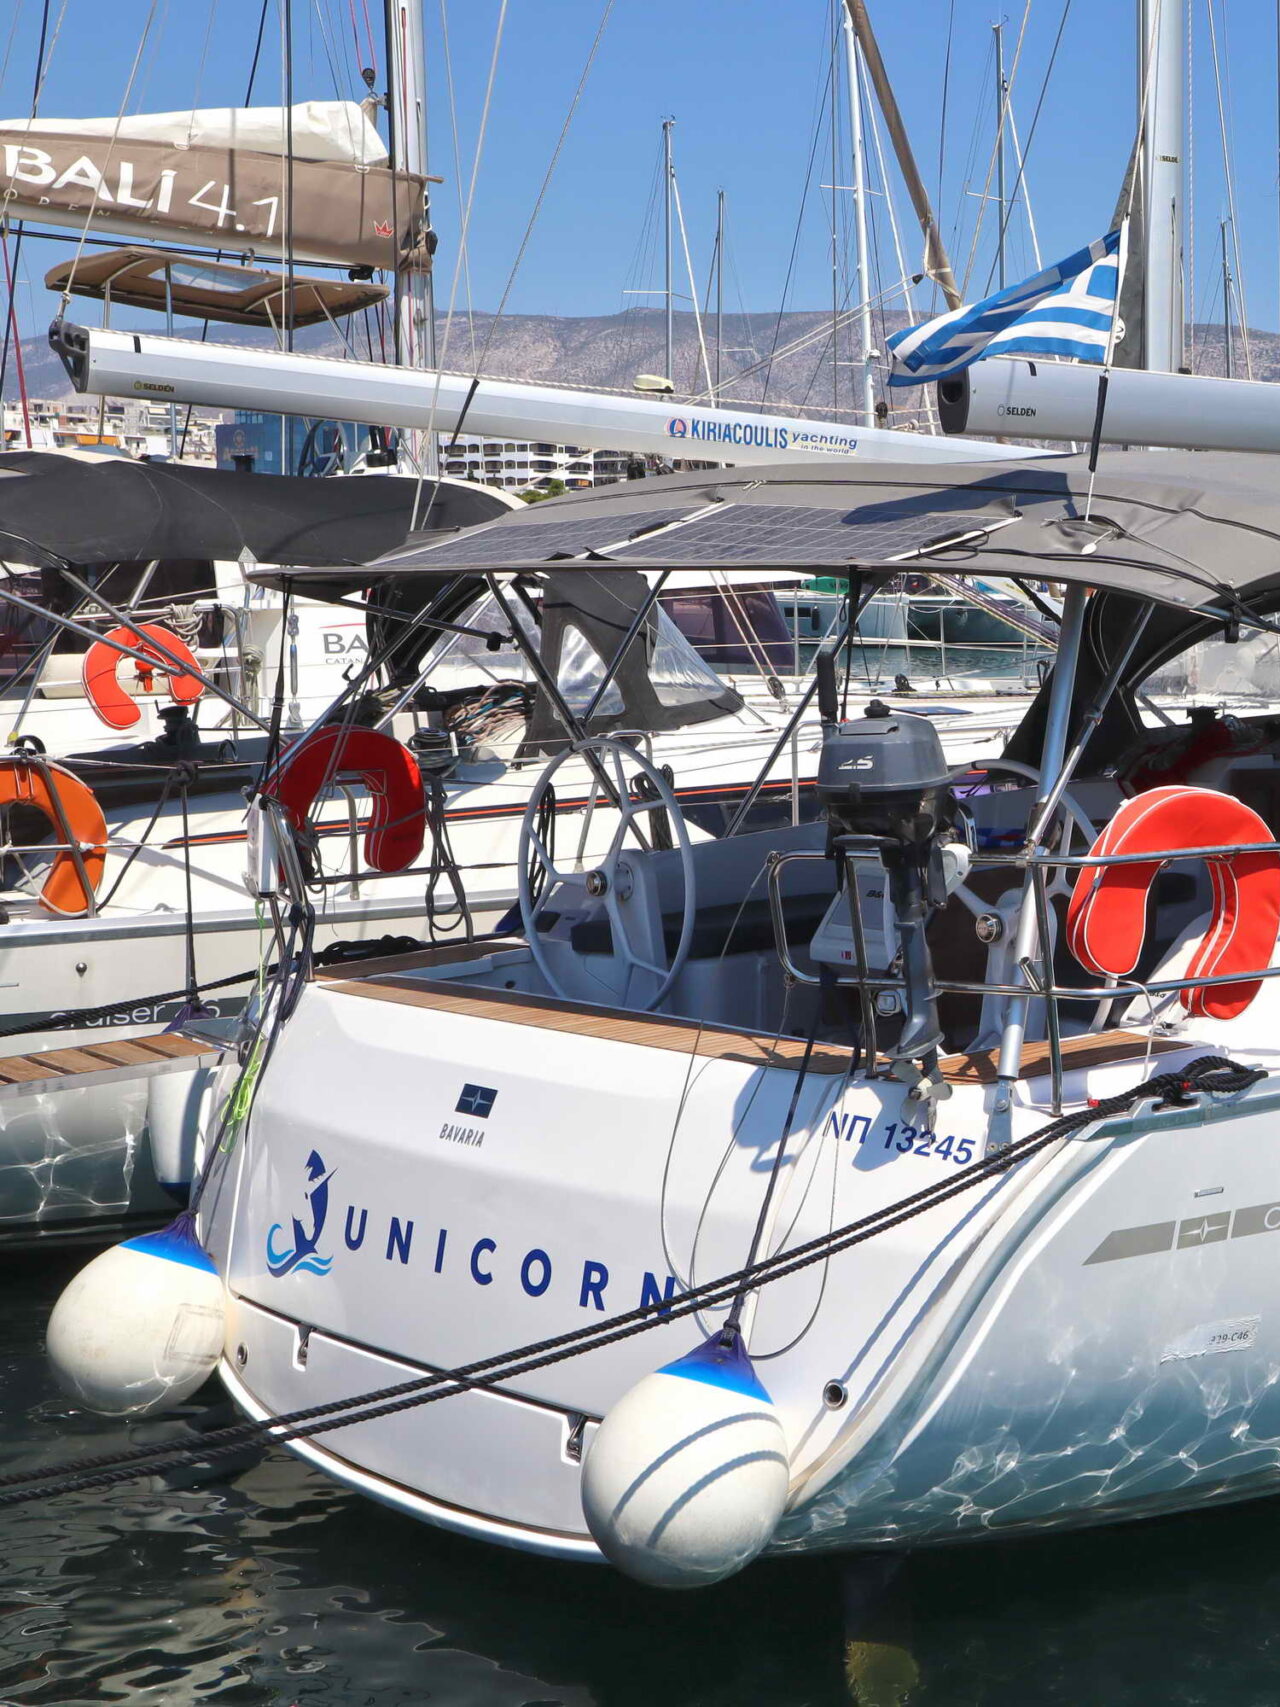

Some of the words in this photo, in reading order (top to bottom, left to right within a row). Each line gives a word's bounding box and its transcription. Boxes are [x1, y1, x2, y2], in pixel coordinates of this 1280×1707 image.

[3, 144, 178, 214] BALI
[188, 180, 279, 238] 4.1
[691, 418, 788, 449] KIRIACOULIS
[792, 431, 858, 450] yachting
[827, 447, 850, 455] world
[439, 1123, 485, 1148] BAVARIA
[884, 1123, 976, 1165] 13245
[344, 1205, 676, 1324] UNICORN
